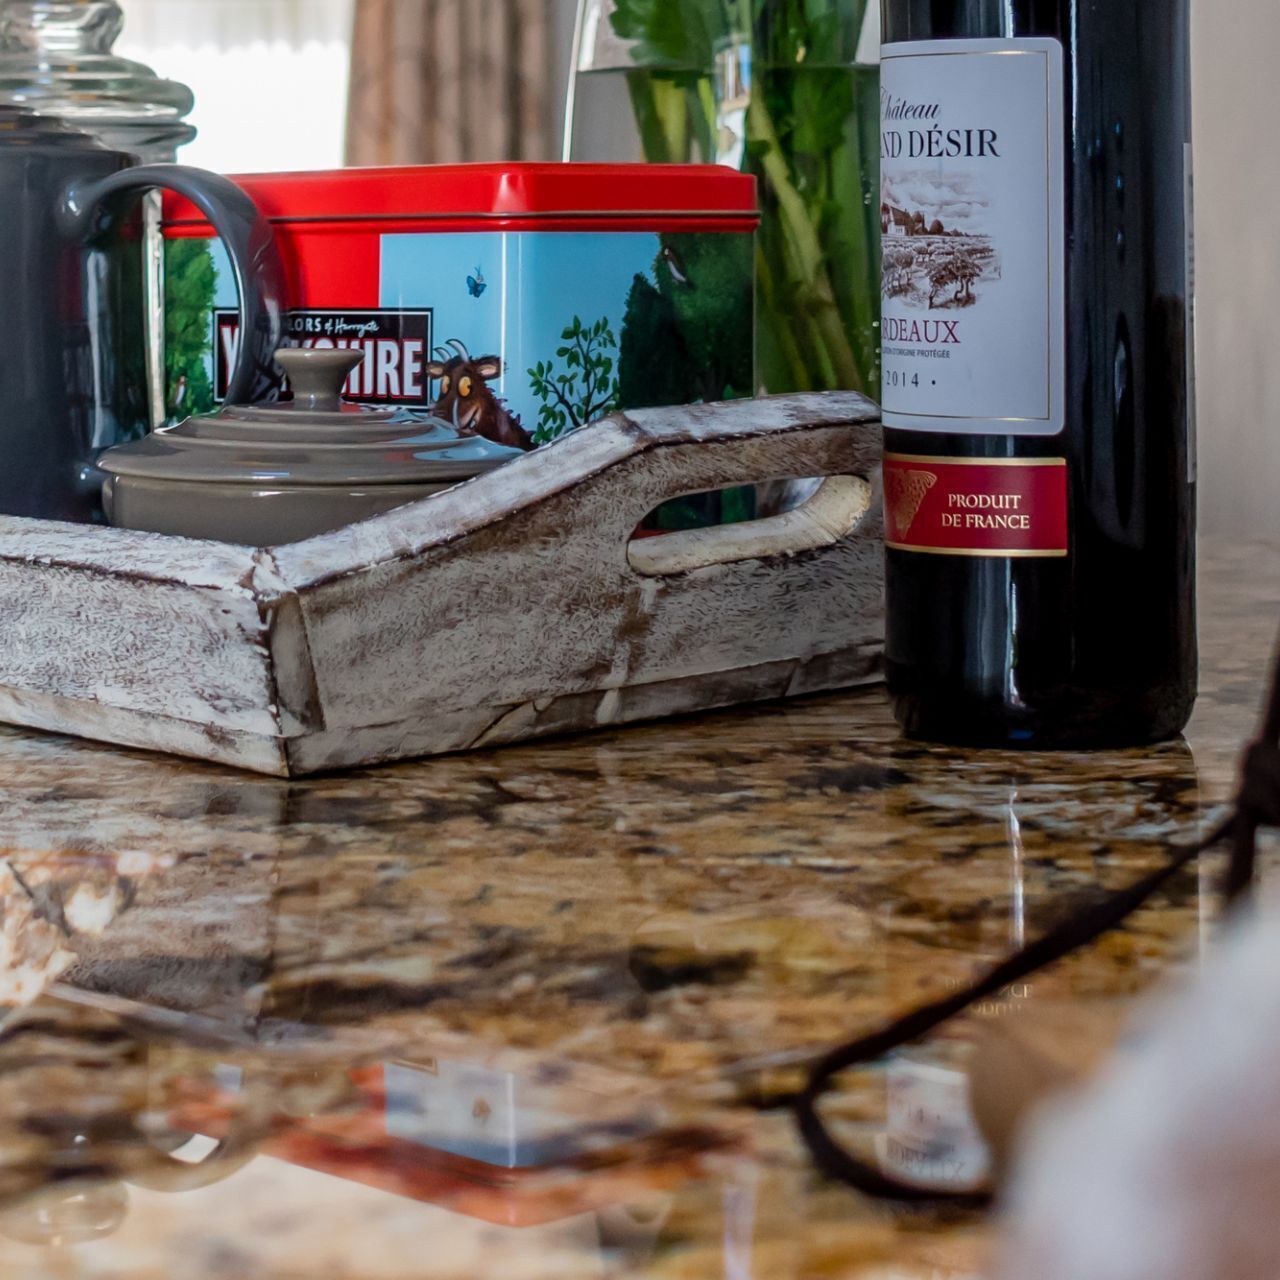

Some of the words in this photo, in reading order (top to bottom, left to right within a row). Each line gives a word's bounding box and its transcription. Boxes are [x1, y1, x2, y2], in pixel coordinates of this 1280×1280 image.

[908, 123, 1001, 157] DÉSIR
[881, 317, 962, 344] RDEAUX
[886, 370, 919, 388] 2014
[948, 493, 1022, 510] PRODUIT
[942, 513, 961, 528] DE
[965, 513, 1030, 530] FRANCE
